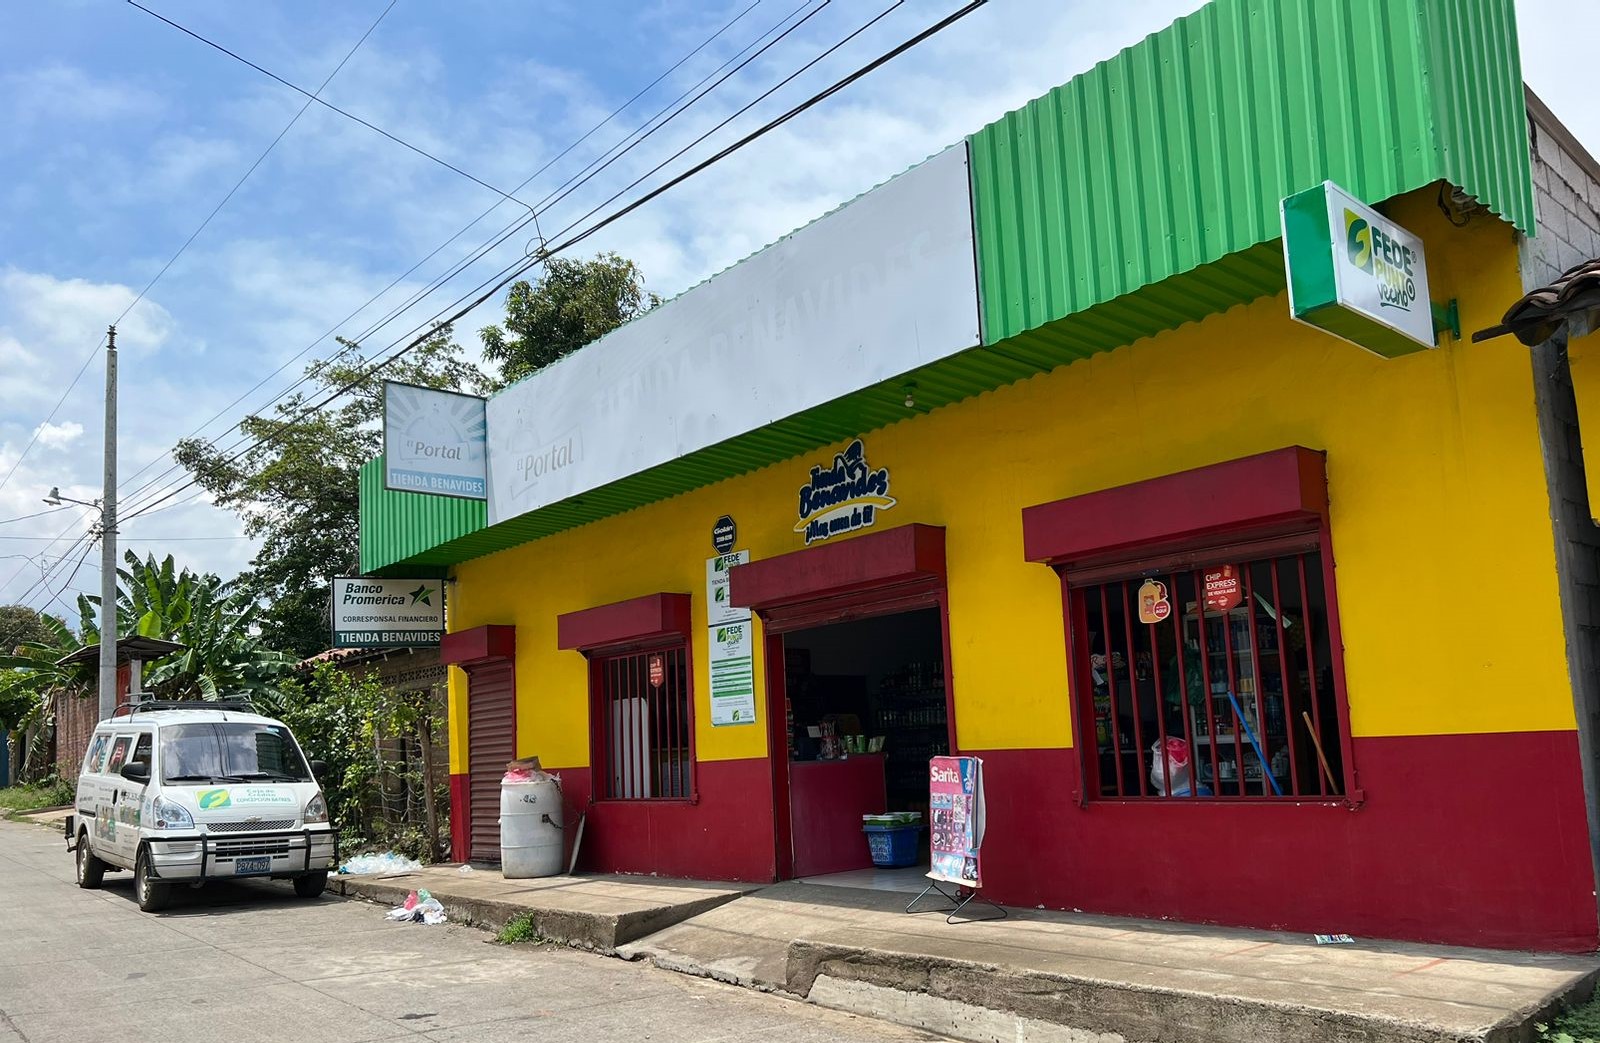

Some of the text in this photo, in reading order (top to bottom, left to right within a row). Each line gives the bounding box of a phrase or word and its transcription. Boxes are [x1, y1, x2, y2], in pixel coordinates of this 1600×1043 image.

[1371, 226, 1413, 277] FEDE
[1374, 257, 1416, 301] PUNTO
[415, 441, 461, 460] Portal
[524, 437, 575, 482] Portal
[391, 473, 483, 493] TIENDA BENAVIDES
[800, 466, 888, 519] Benavides
[723, 552, 740, 564] FEDE
[1205, 572, 1221, 582] CHIP
[1206, 578, 1237, 590] EXPRESS
[345, 583, 383, 594] Banco
[343, 594, 406, 605] Promerica
[339, 632, 441, 643] TIENDA BENAVIDES
[726, 625, 742, 635] FEDE
[931, 766, 960, 784] Sarita
